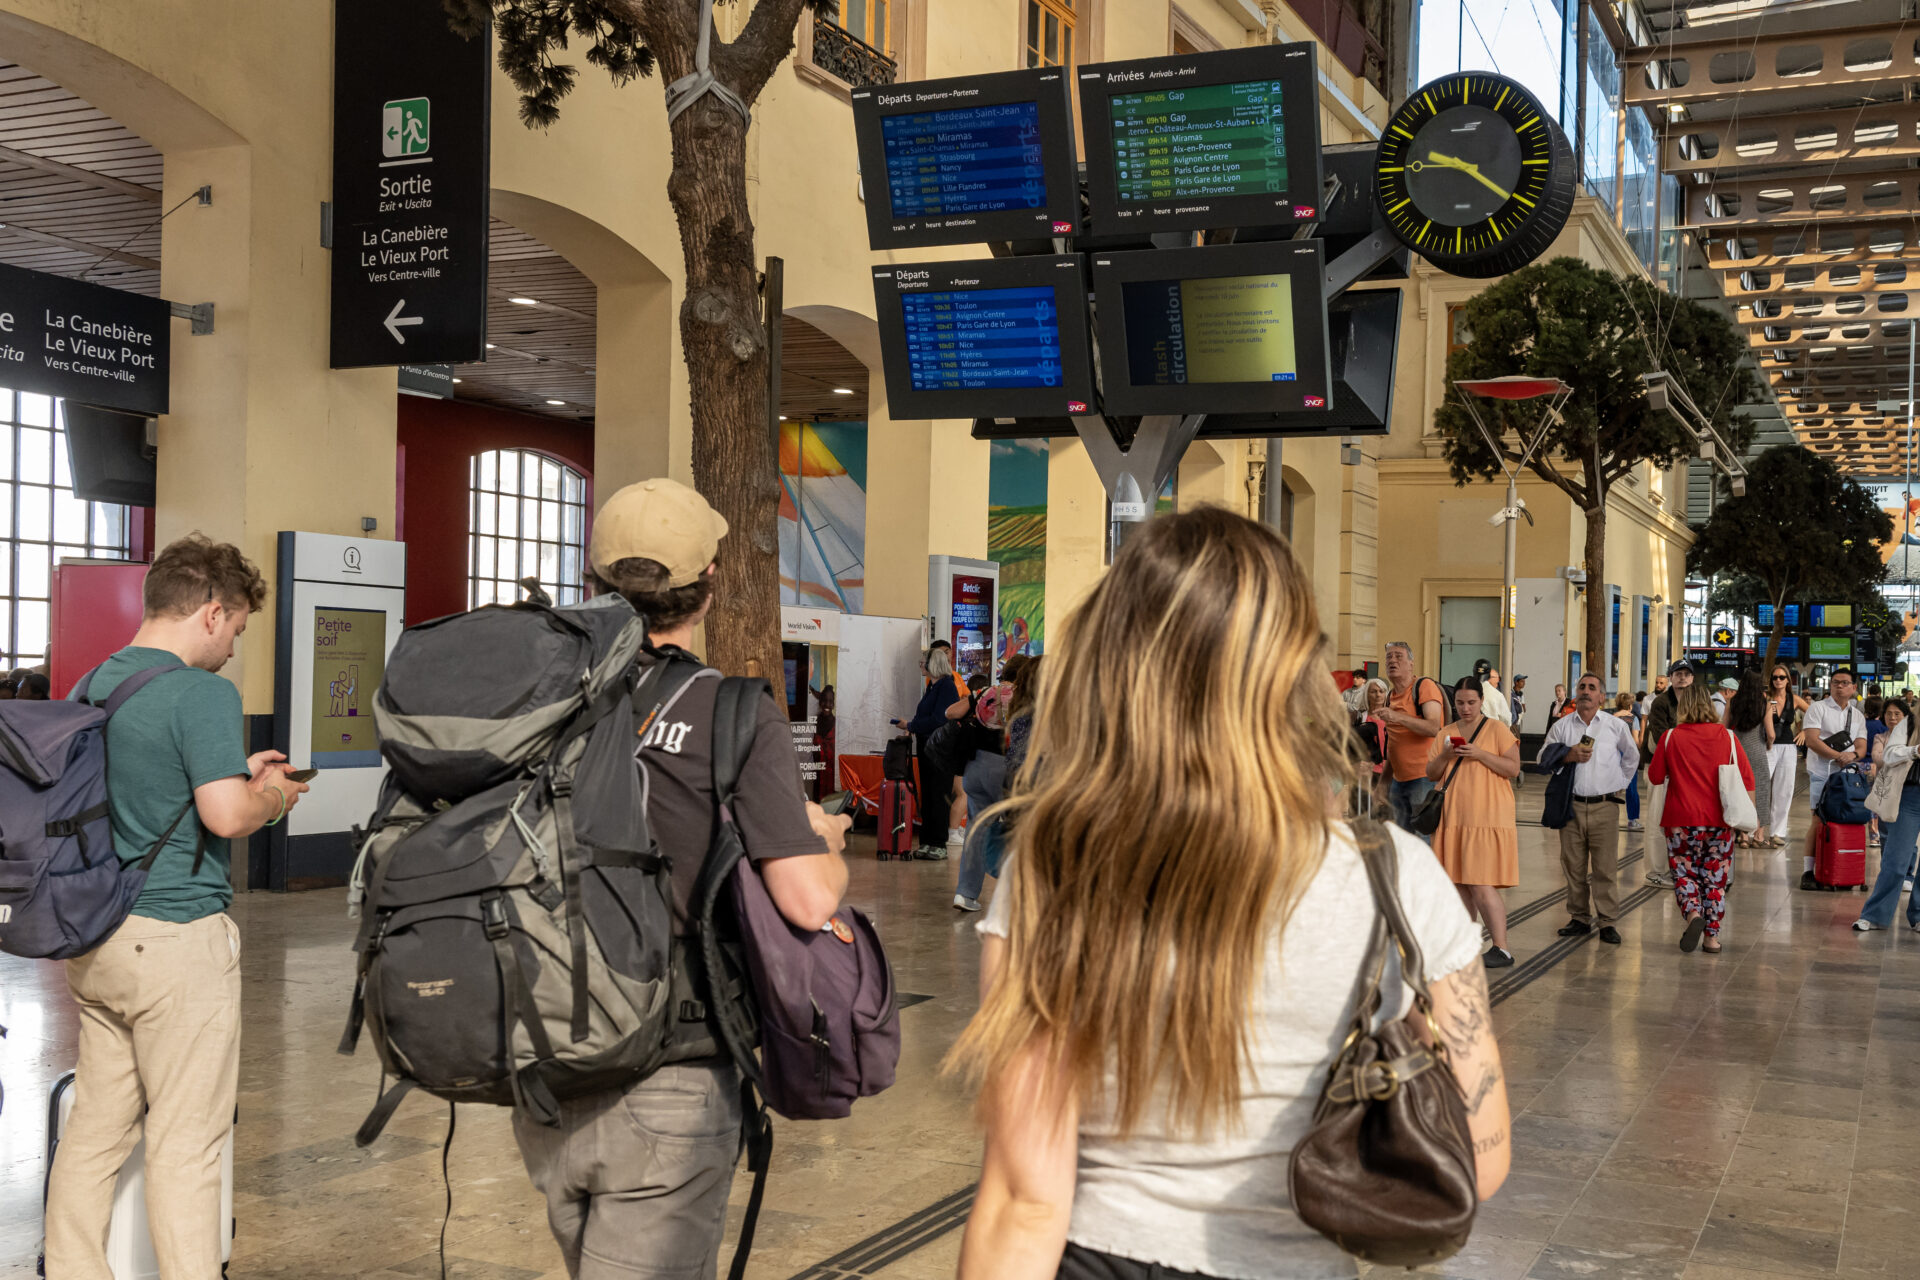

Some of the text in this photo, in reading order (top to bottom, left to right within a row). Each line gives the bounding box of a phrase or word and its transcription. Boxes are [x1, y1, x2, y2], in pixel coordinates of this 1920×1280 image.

[1107, 71, 1145, 83] Arrivées
[1149, 69, 1173, 79] Arrivals
[878, 93, 912, 106] Départs
[916, 92, 948, 102] Departures
[1168, 91, 1185, 101] Gap
[1247, 95, 1263, 103] Gap
[935, 110, 973, 122] Bordeaux
[975, 106, 1020, 117] Saint-Jean
[1146, 113, 1187, 124] 09h10 Gap
[1154, 119, 1250, 133] Château-Arnoux-St-Auban
[937, 132, 973, 143] Miramas
[1148, 137, 1167, 145] 09h14
[1172, 134, 1203, 142] Miramas
[1173, 142, 1232, 153] Aix-en-Provence
[939, 152, 976, 162] Strasbourg
[1174, 155, 1202, 165] Avignon
[1204, 153, 1229, 161] Centre
[1174, 166, 1191, 175] Paris
[1193, 165, 1210, 173] Gare
[1211, 164, 1220, 172] de
[1222, 163, 1240, 174] Lyon
[1175, 177, 1192, 185] Paris
[1194, 176, 1211, 184] Gare
[1223, 174, 1241, 184] Lyon
[380, 174, 432, 197] Sortie
[1176, 186, 1235, 196] Aix-en-Provence
[379, 198, 432, 212] Exit Uscita
[945, 201, 1005, 212] Paris Gare de Lyon
[1175, 205, 1210, 214] provenance
[1294, 209, 1314, 218] SNCF
[892, 224, 906, 232] train
[945, 219, 976, 227] destination
[1053, 224, 1072, 233] SNCF
[363, 225, 448, 246] La Canebière
[361, 246, 449, 267] Le Vieux Port
[368, 267, 441, 282] Vers Centre-ville
[896, 270, 930, 281] Départs
[897, 278, 980, 290] Departures Partenze
[955, 302, 977, 310] Toulon
[956, 311, 982, 320] Avignon
[983, 311, 1006, 319] Centre
[46, 309, 152, 346] La Canebière
[957, 321, 973, 329] Paris
[974, 321, 989, 329] Gare
[990, 320, 998, 328] de
[1000, 319, 1016, 328] Lyon
[1166, 285, 1185, 384] circulation
[959, 341, 974, 349] Nice
[1035, 300, 1058, 387] départs
[45, 332, 155, 369] Le Vieux Port
[44, 355, 136, 383] Vers Centre-ville
[961, 360, 989, 368] Miramas
[405, 365, 422, 375] Punto
[962, 368, 1029, 378] Bordeaux Saint-Jean
[963, 379, 986, 387] Toulon
[1069, 404, 1086, 412] SNCF
[1304, 399, 1324, 407] SNCF
[962, 583, 981, 593] Betclic
[317, 616, 352, 632] Petite
[787, 621, 817, 631] World Vision
[316, 631, 338, 646] soif
[801, 771, 817, 780] VIES
